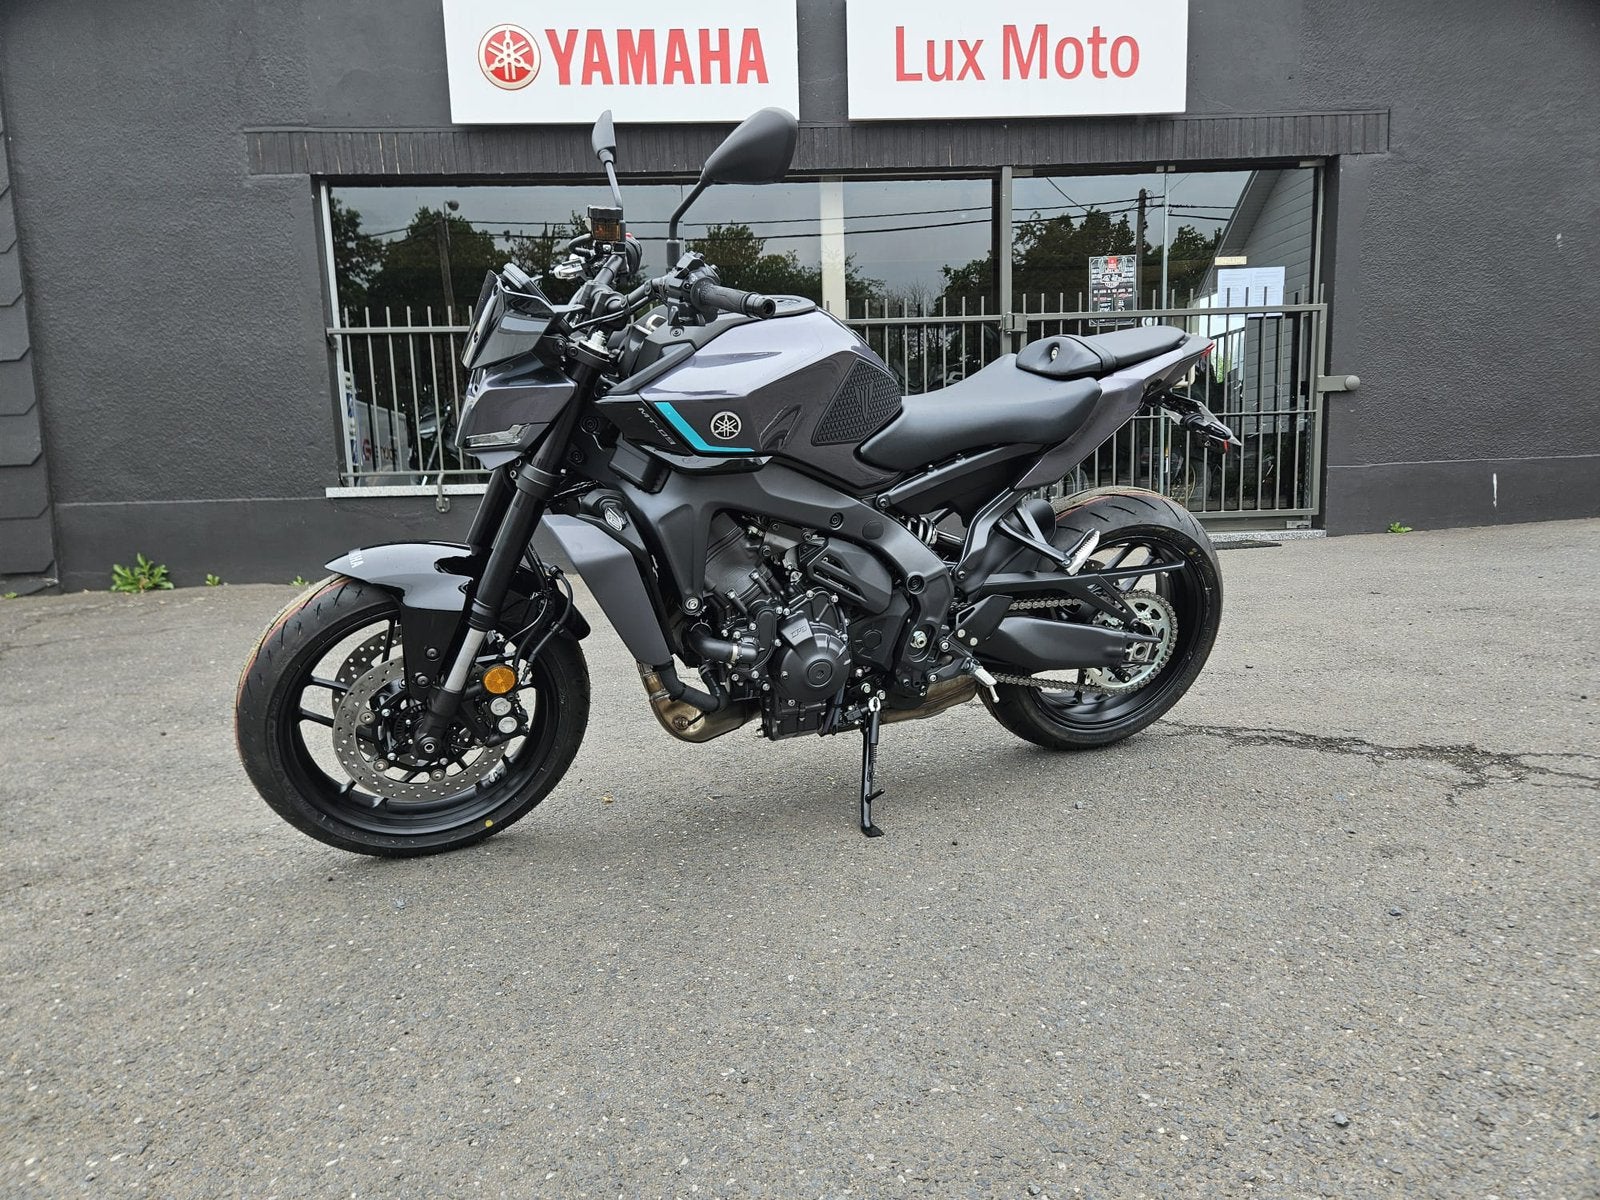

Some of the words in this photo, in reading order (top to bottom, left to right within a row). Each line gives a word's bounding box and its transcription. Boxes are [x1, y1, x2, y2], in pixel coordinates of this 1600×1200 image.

[544, 28, 769, 85] YAMAHA
[895, 26, 986, 82] Lux
[1002, 24, 1140, 80] Moto
[637, 407, 676, 445] MT-09
